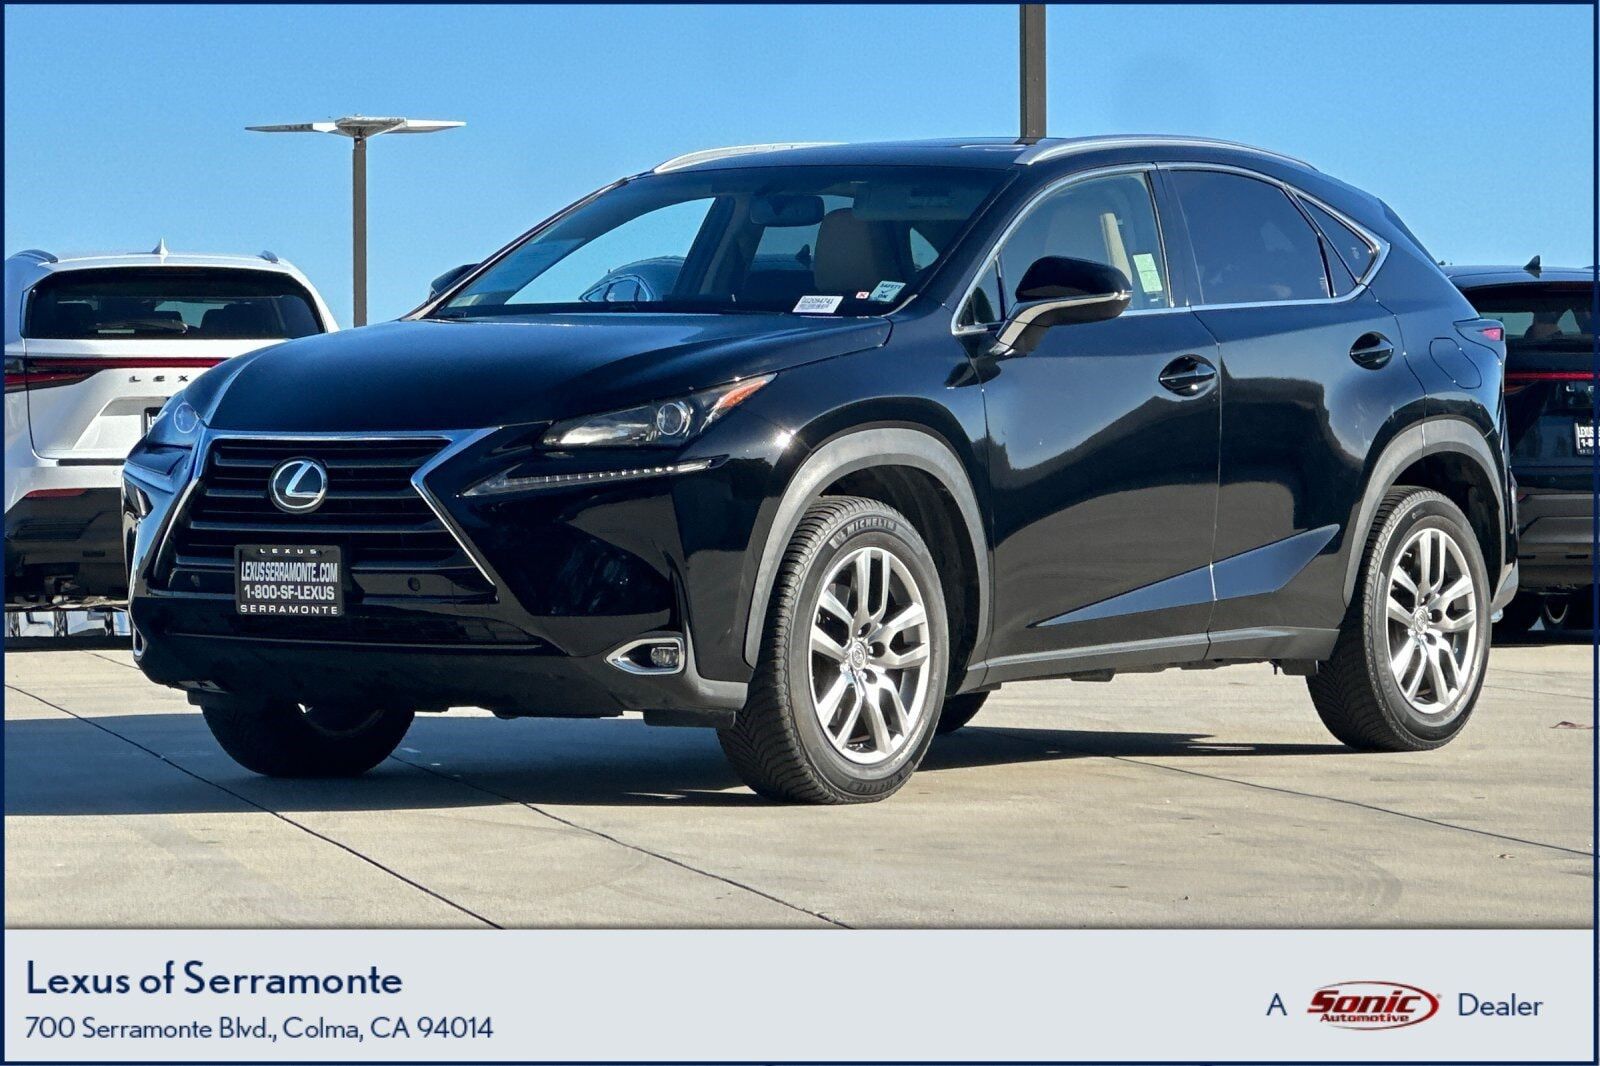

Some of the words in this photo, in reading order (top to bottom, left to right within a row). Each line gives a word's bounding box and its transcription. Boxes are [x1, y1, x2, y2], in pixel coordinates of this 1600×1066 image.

[128, 375, 189, 383] LEX
[846, 517, 897, 535] MICHELIN
[241, 561, 338, 582] LEXUSSERRAMONTE.COM
[244, 584, 335, 600] 1-800-SF-LEXUS
[240, 604, 338, 615] SERRAMONTE
